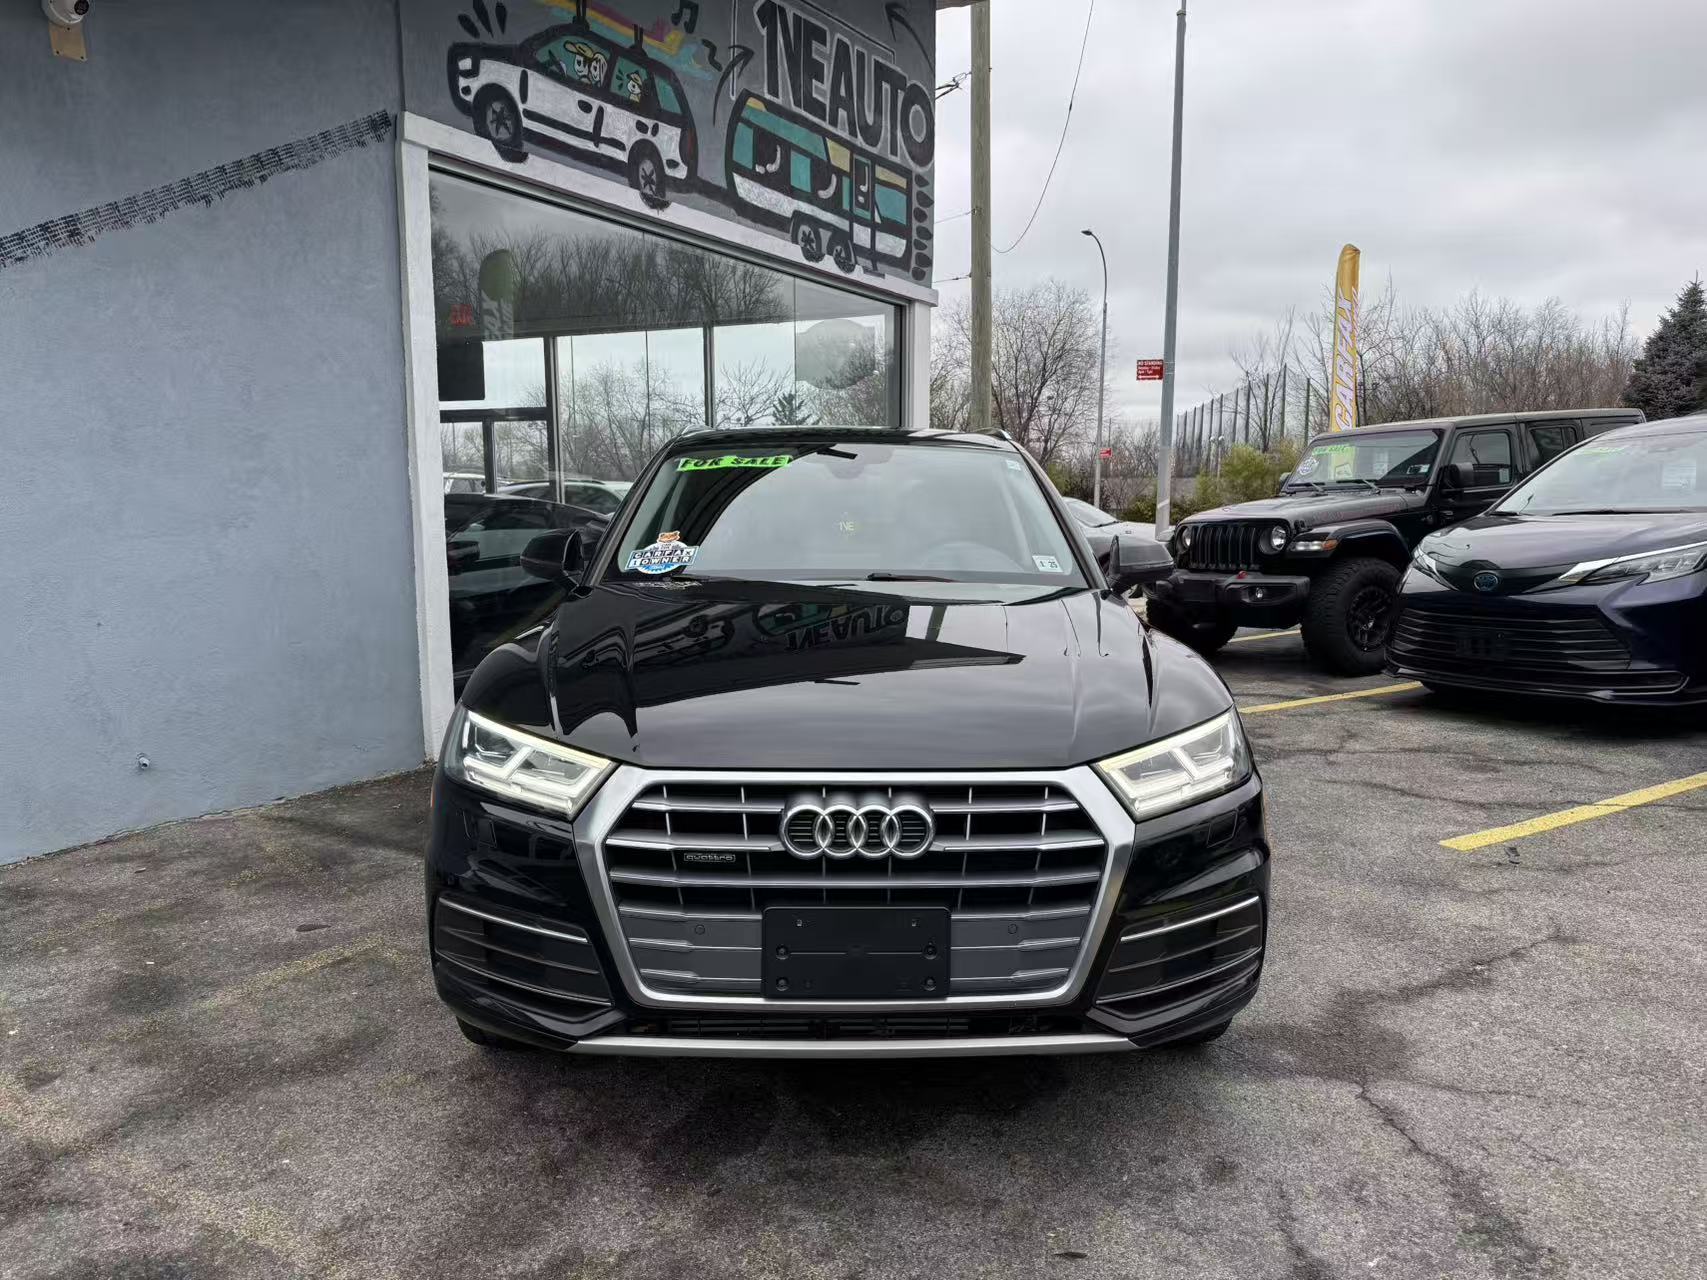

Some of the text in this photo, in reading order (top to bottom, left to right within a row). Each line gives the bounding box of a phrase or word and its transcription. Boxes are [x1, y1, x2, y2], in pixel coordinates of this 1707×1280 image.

[1335, 287, 1355, 431] CARFAX
[680, 457, 784, 468] FOR SALE
[633, 549, 693, 559] CARFAX
[641, 556, 691, 566] OWNER
